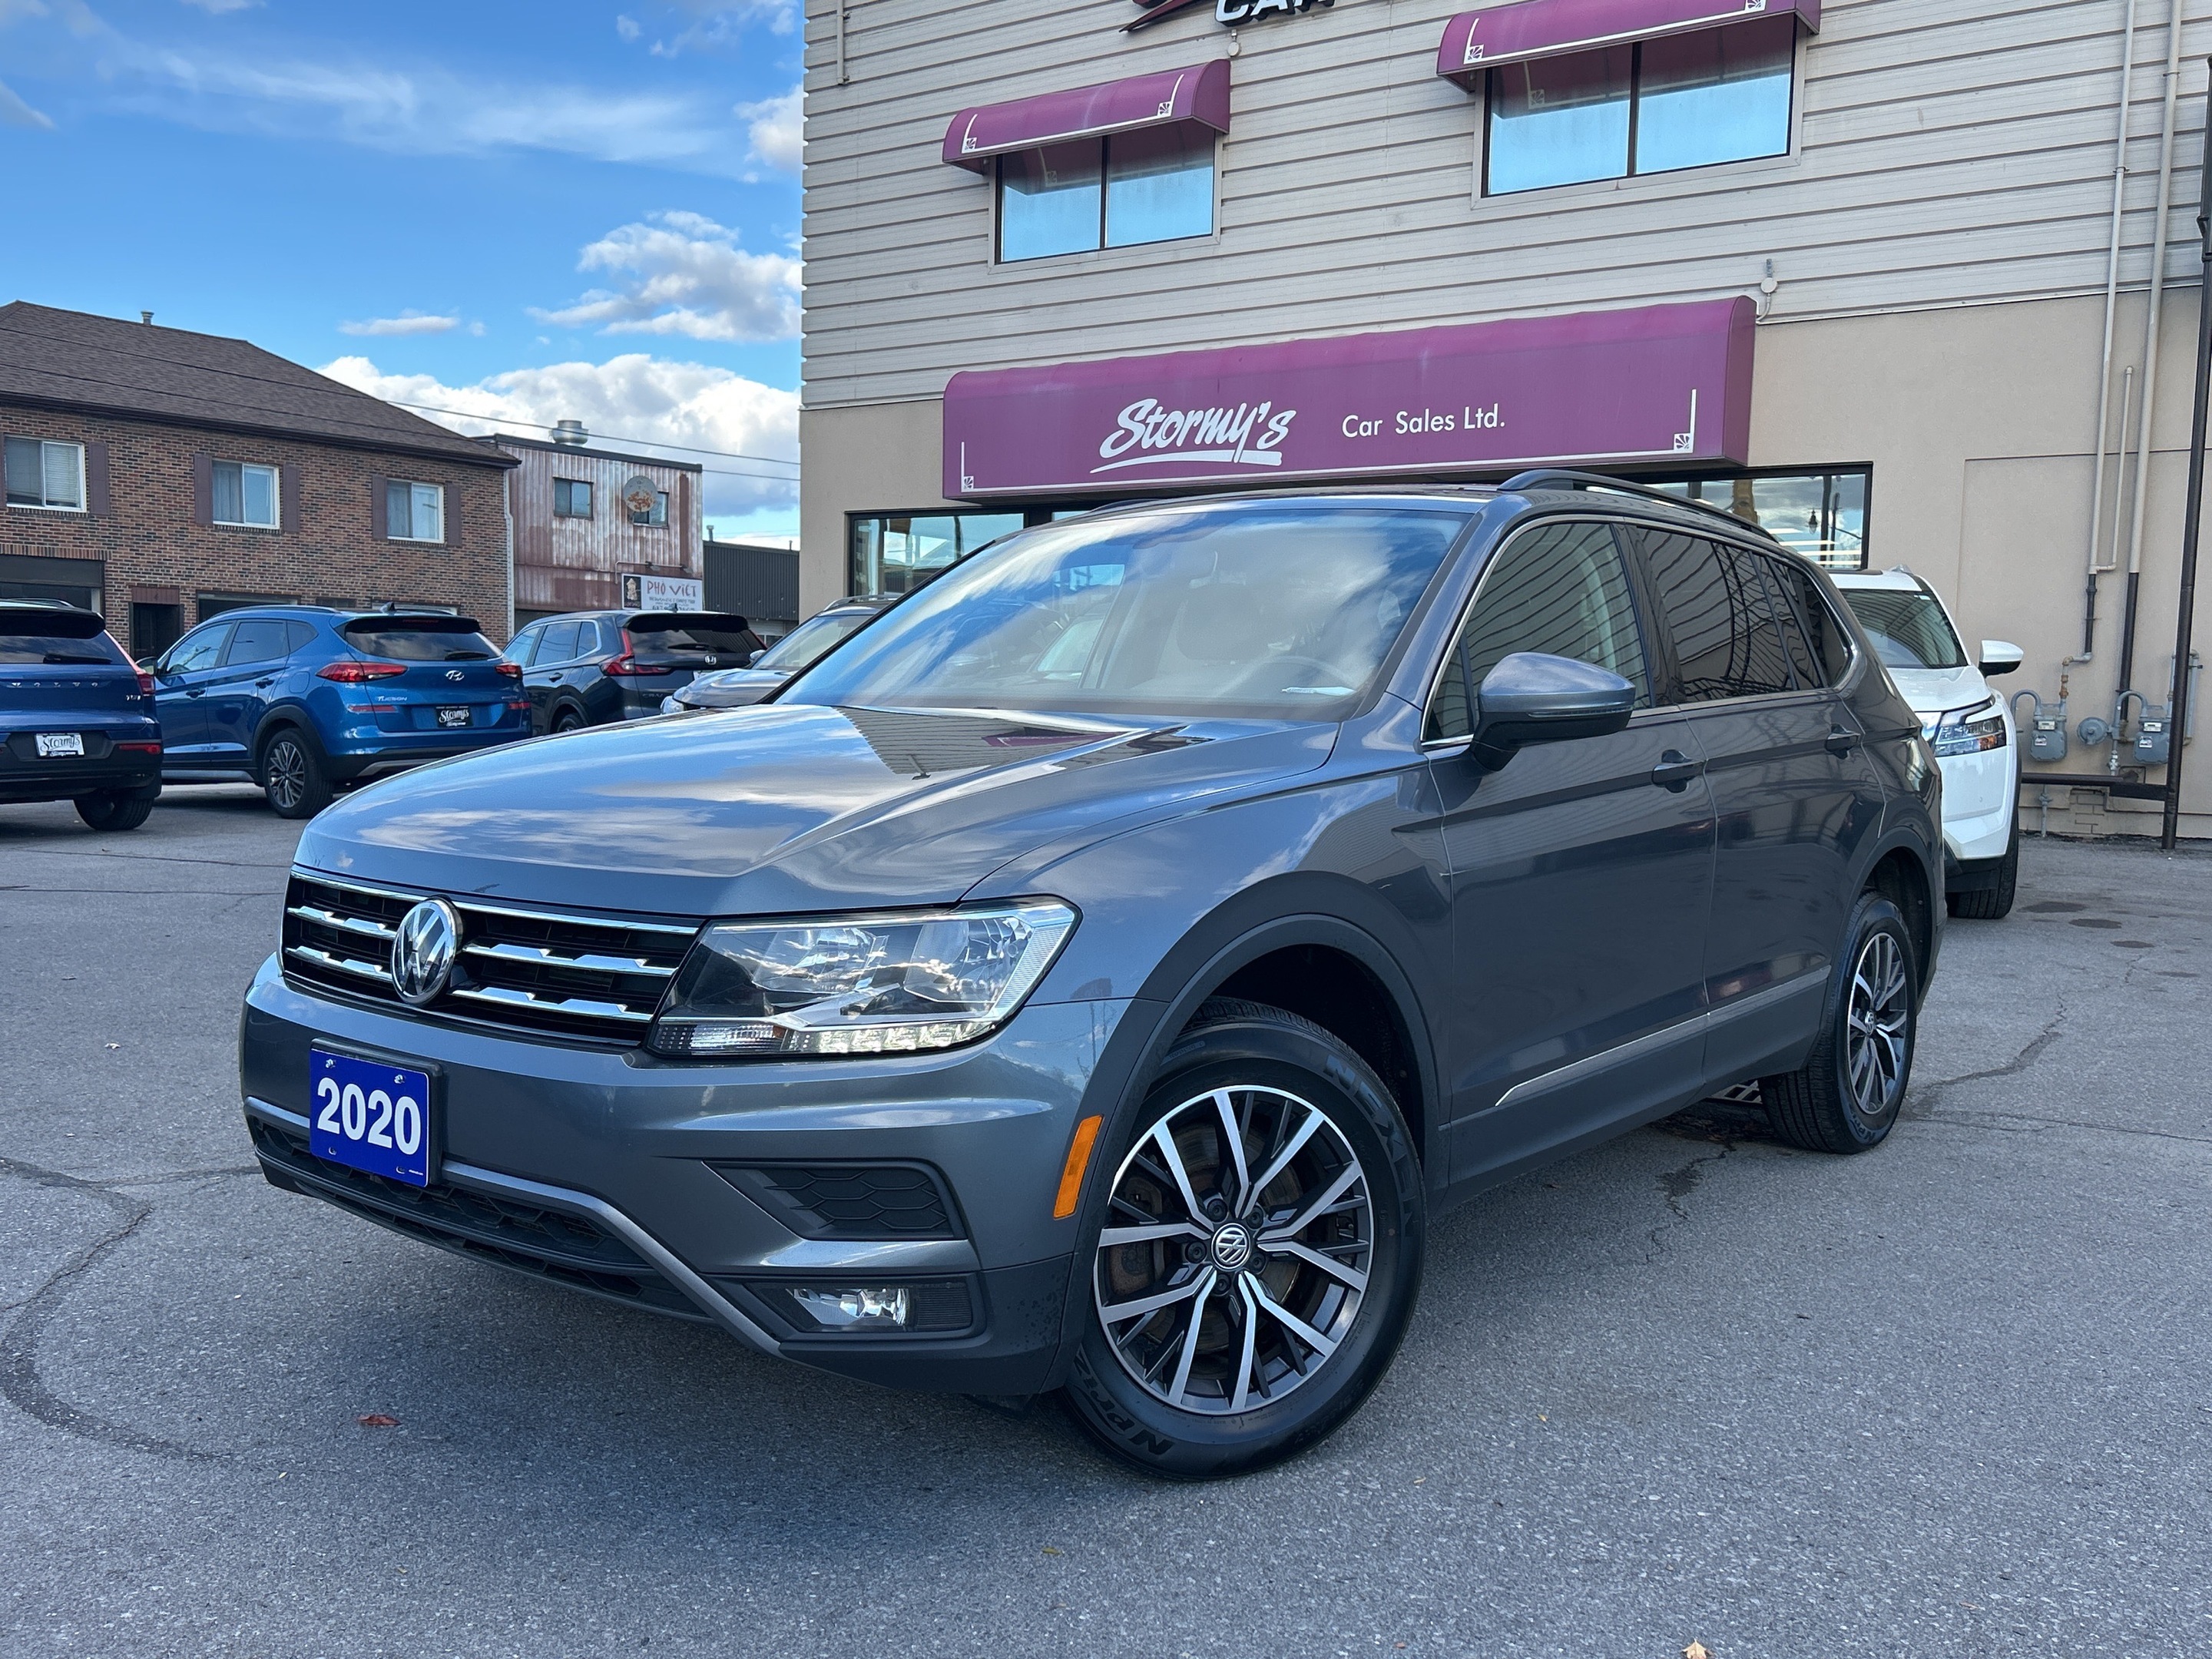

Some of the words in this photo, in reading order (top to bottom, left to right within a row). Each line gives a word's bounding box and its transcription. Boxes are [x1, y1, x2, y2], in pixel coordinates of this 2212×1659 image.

[1098, 398, 1297, 464] Stormy's
[1341, 414, 1383, 439] Car
[1395, 408, 1455, 435] Sales
[1463, 402, 1505, 430] Ltd.
[316, 1077, 422, 1155] 2020
